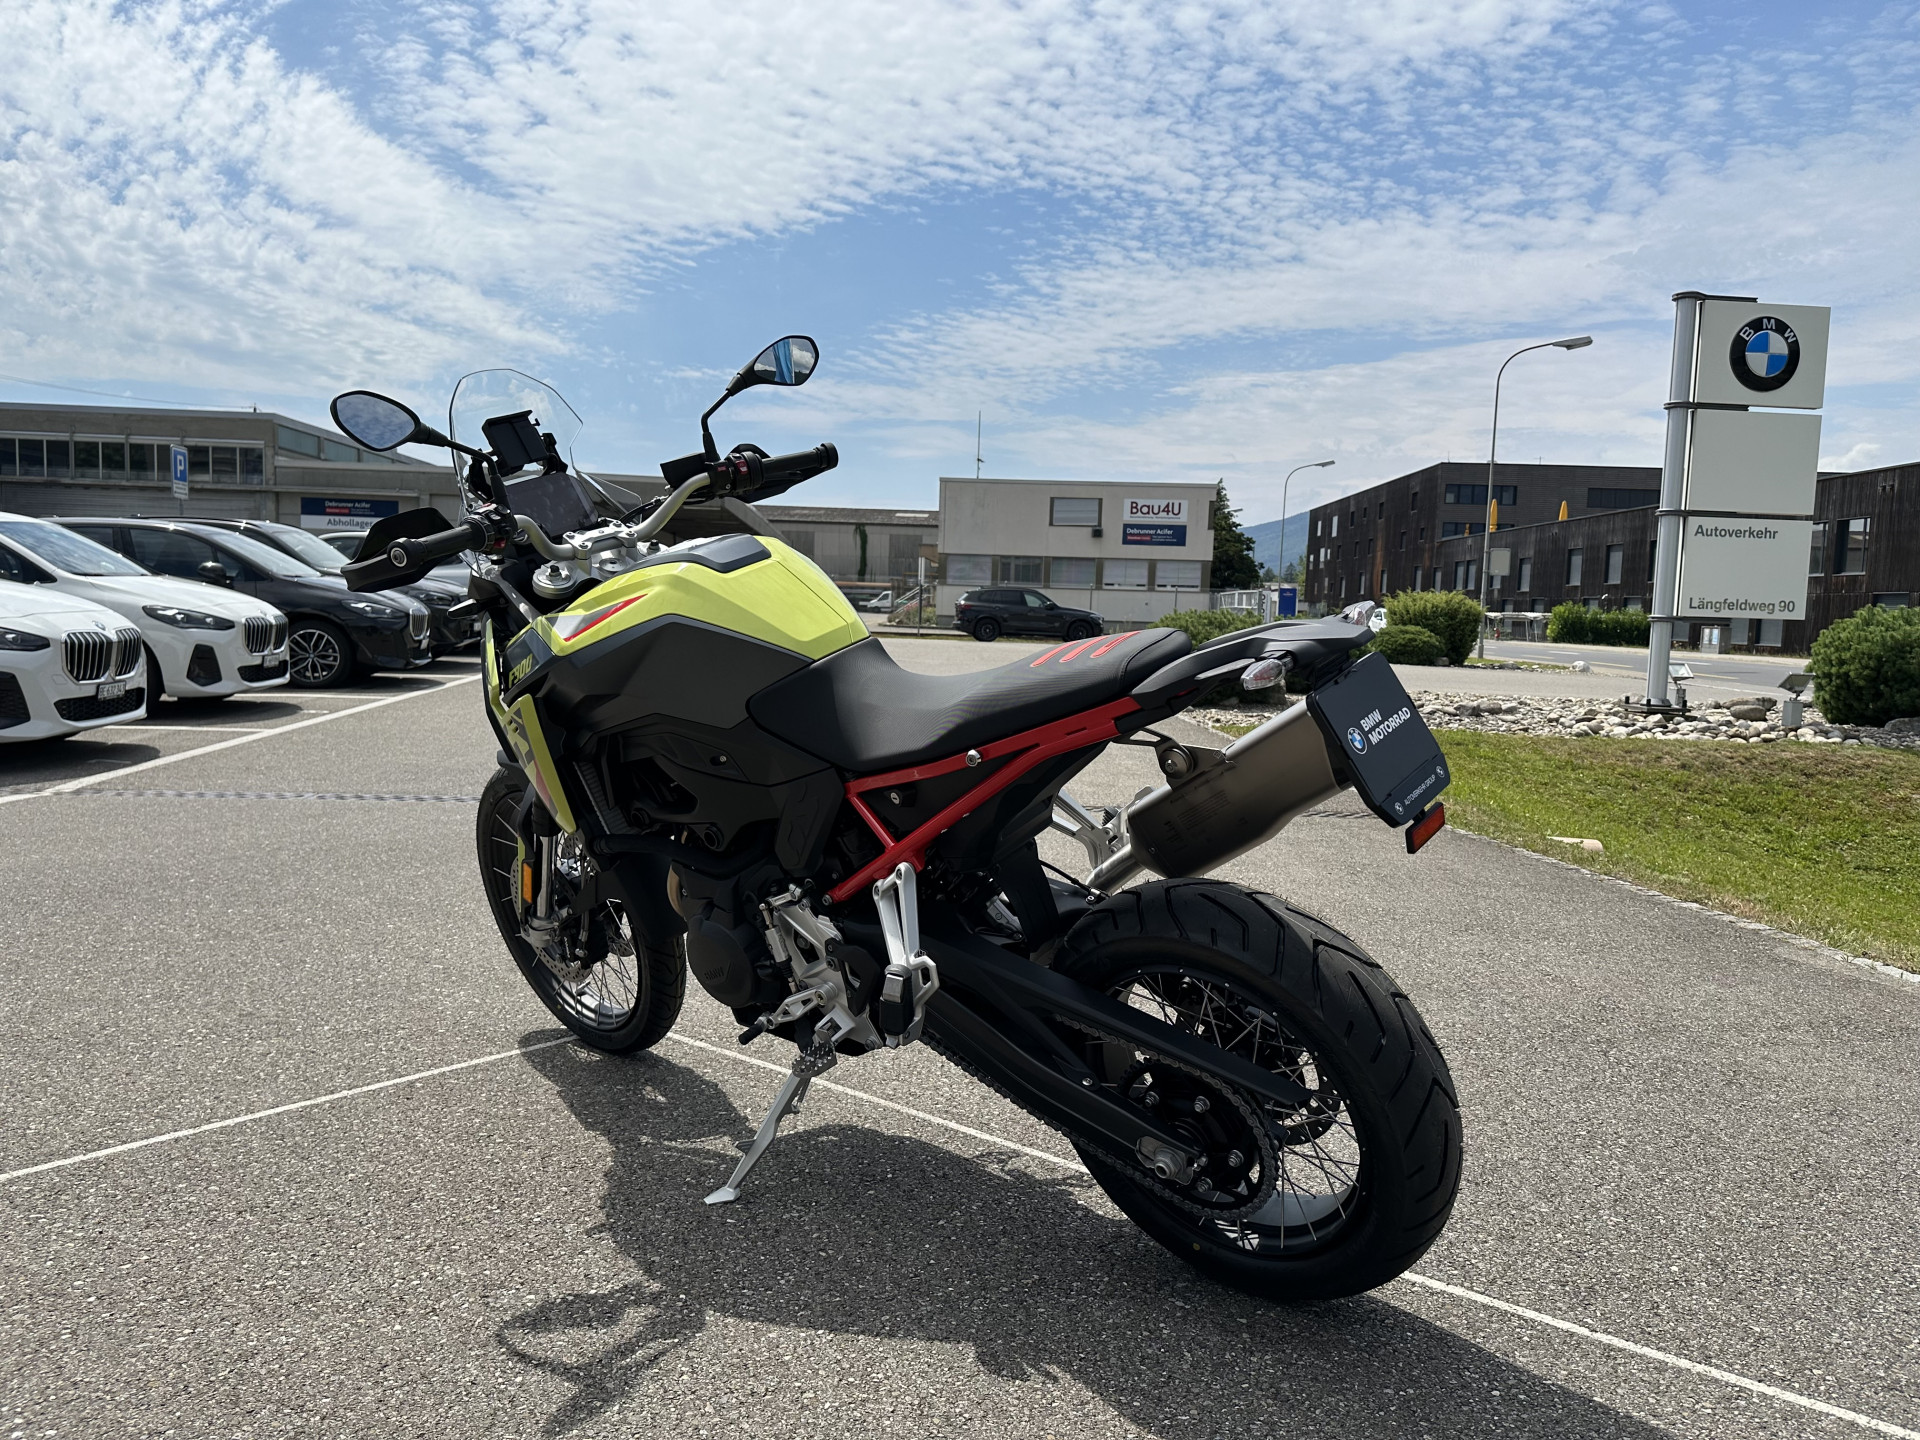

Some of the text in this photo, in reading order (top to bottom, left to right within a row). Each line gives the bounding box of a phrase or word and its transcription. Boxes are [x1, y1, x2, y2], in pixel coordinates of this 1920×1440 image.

[1739, 318, 1798, 343] BMW
[177, 455, 185, 478] P
[1130, 501, 1181, 516] Bau4U
[327, 518, 373, 529] Abhollager
[1694, 524, 1778, 539] Autoverkehr
[1689, 597, 1795, 614] Längfeldweg 90
[1360, 708, 1382, 731] BMW
[1368, 707, 1411, 745] MOTORRAD
